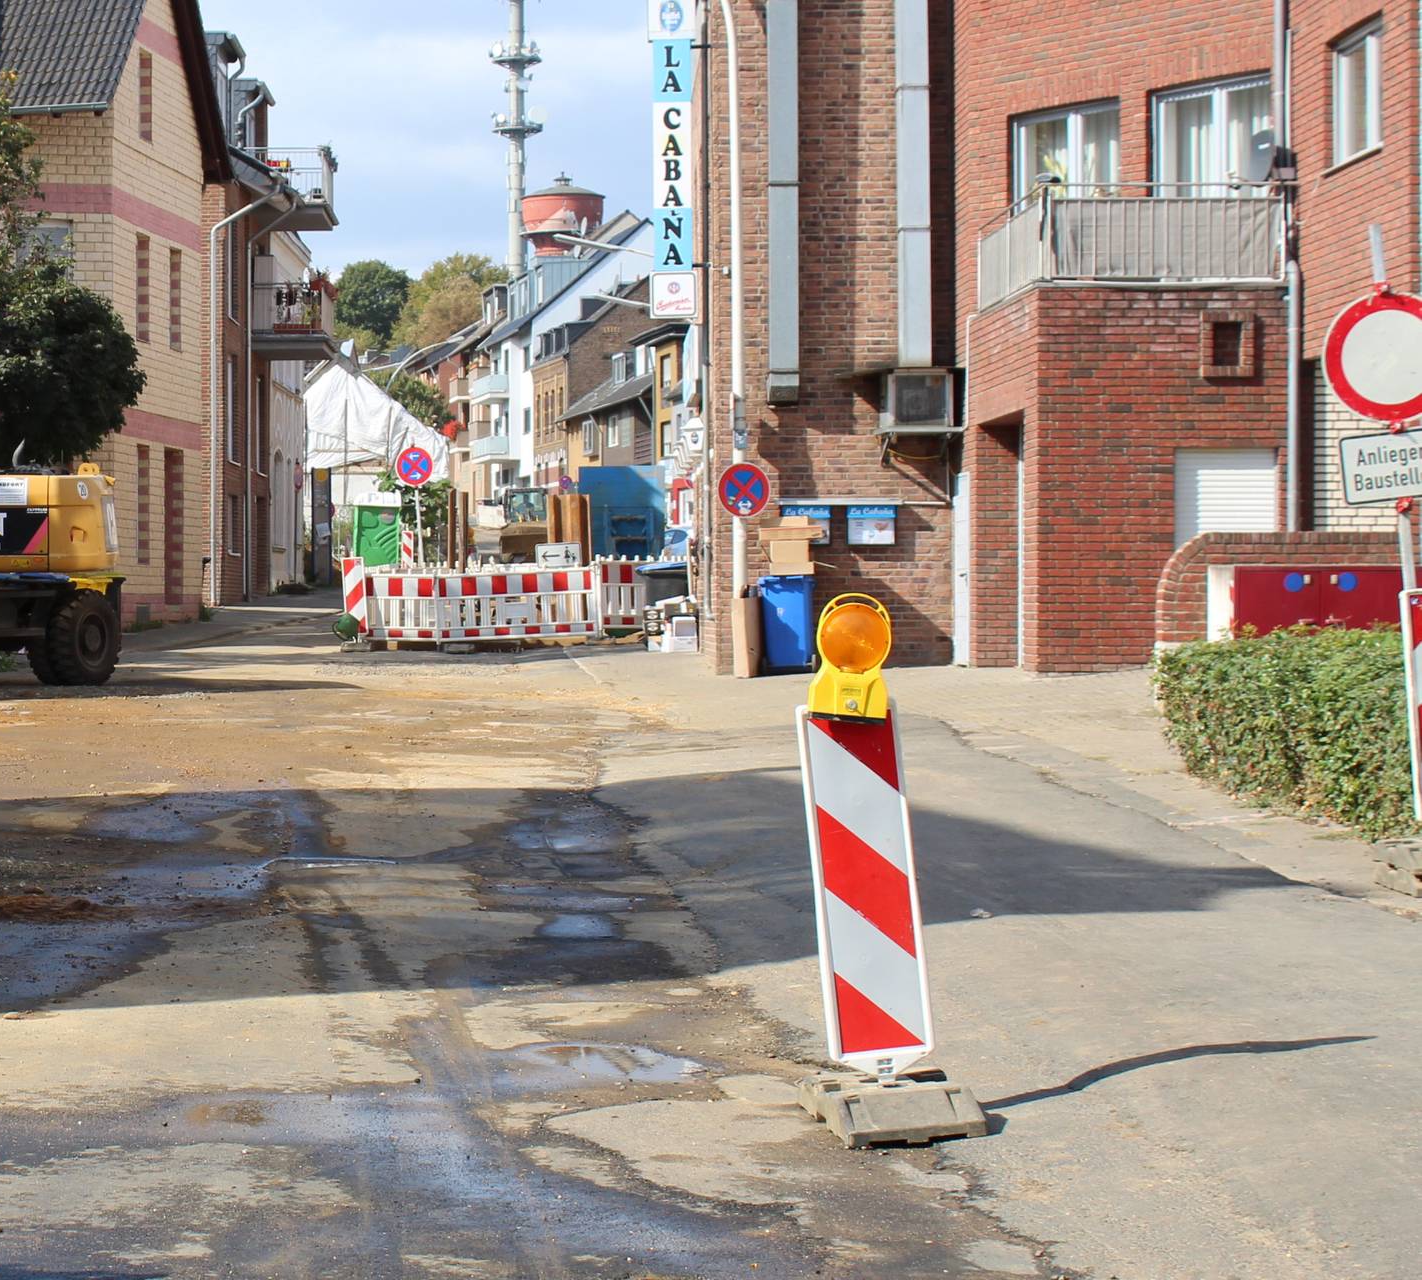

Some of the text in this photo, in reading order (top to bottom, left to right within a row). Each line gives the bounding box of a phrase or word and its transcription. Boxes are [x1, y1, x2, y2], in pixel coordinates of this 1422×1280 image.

[661, 45, 682, 92] LA
[661, 107, 684, 265] CABAÑA
[1354, 466, 1422, 491] Baustell
